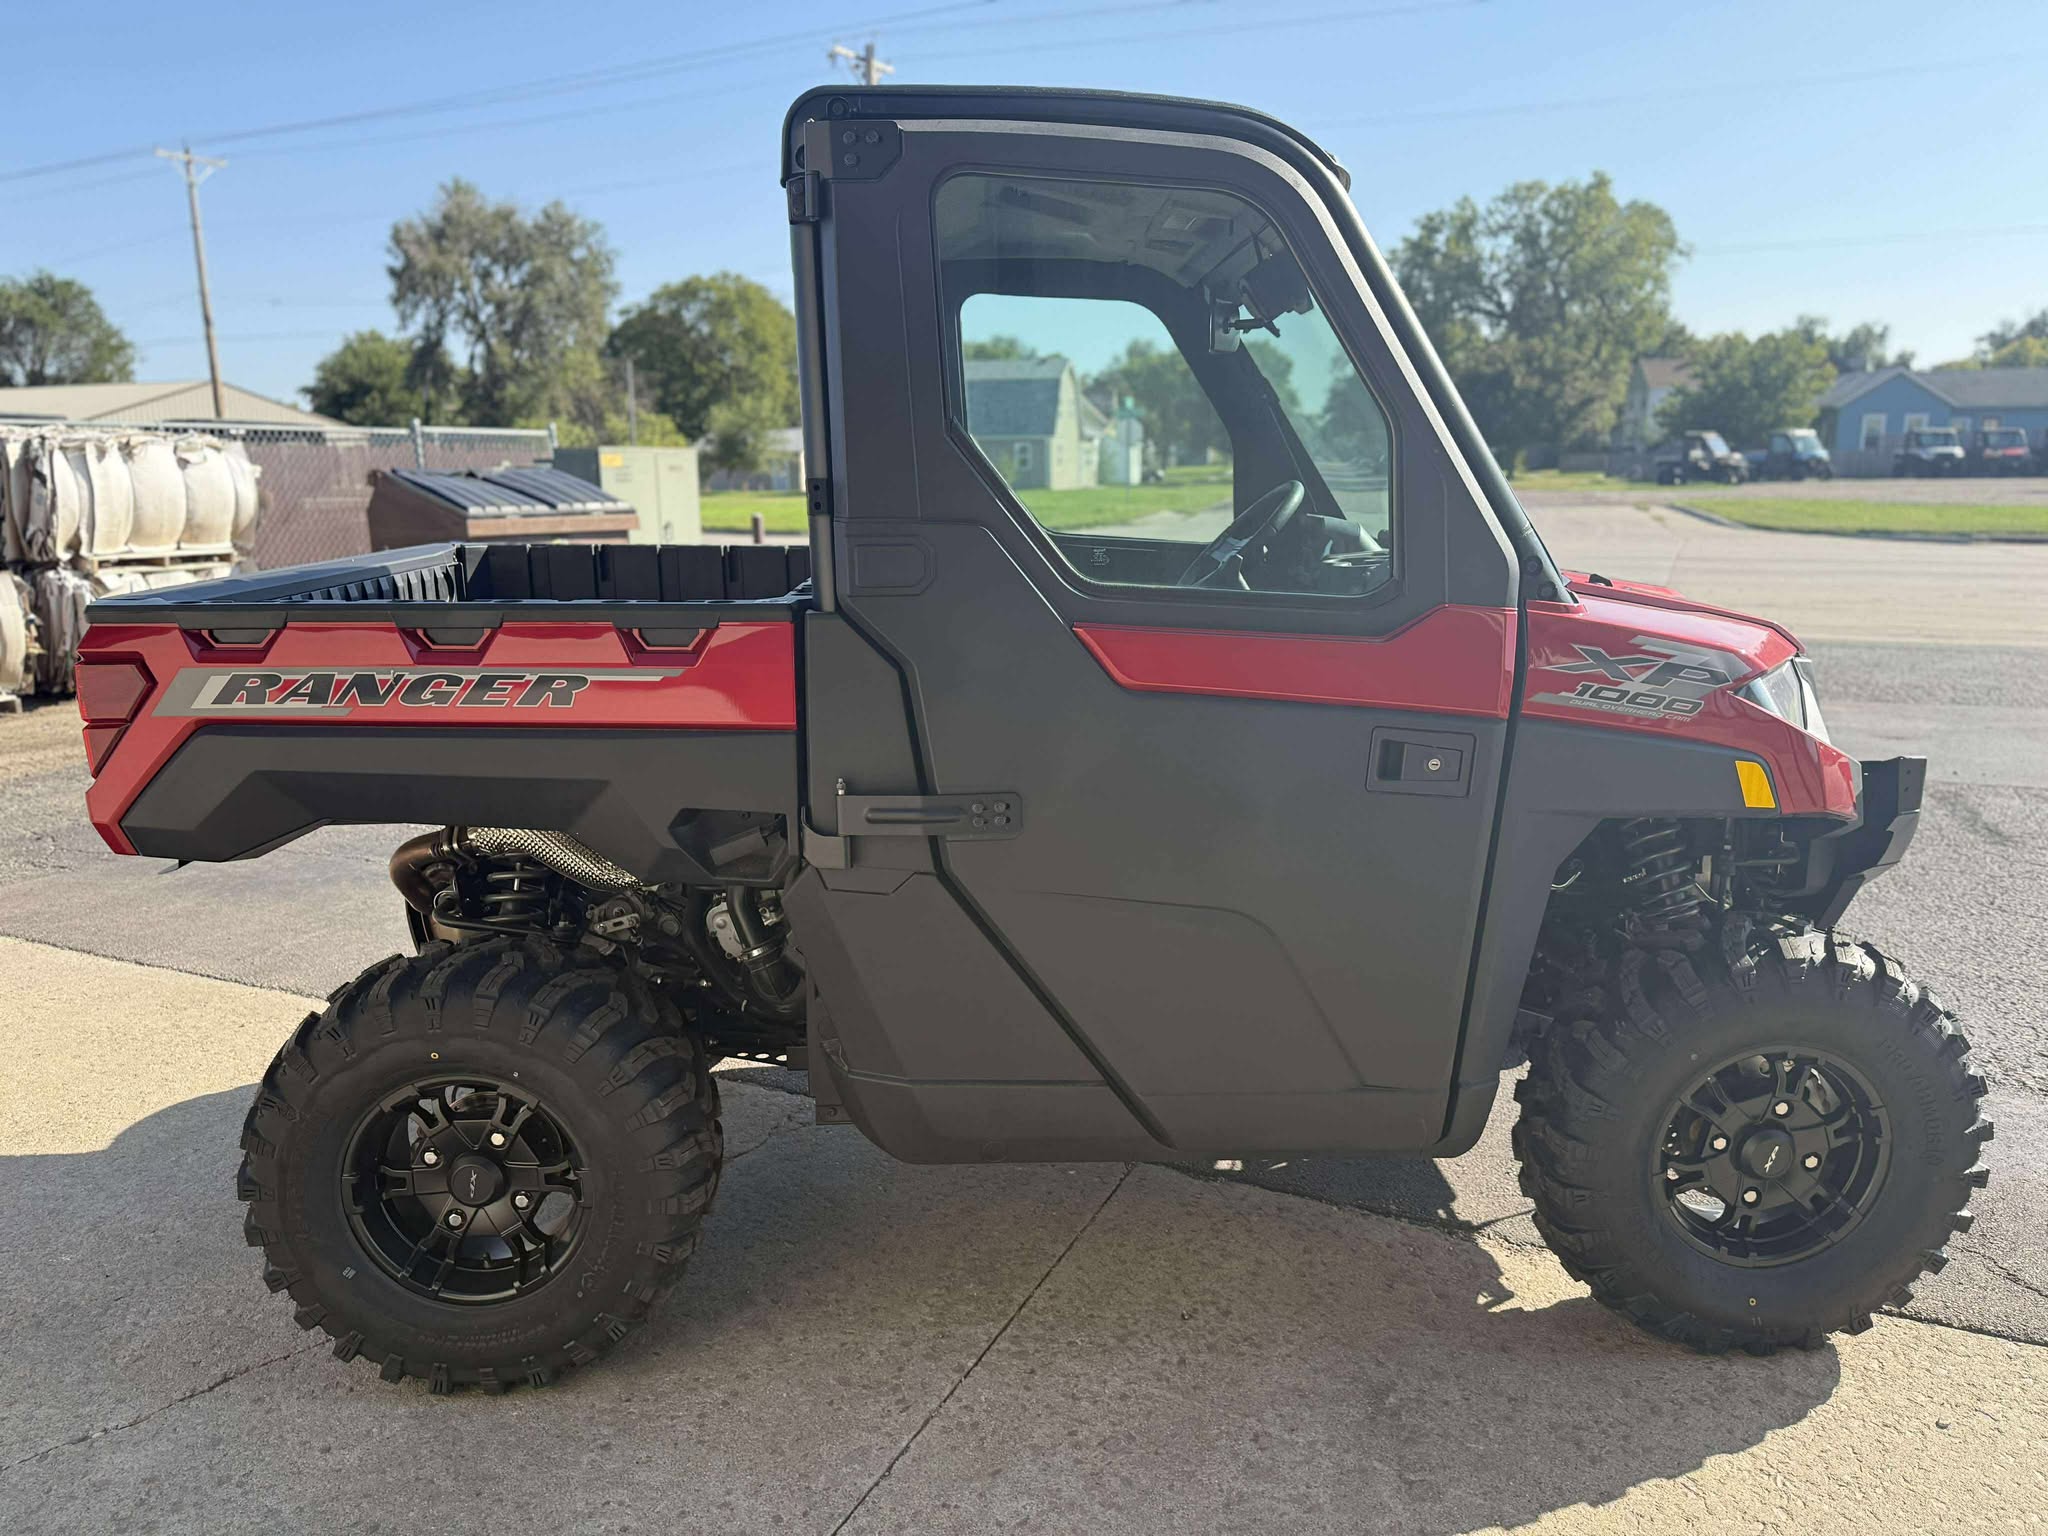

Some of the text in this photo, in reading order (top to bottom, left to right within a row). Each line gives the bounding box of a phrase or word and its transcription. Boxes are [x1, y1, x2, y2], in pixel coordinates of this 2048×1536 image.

[1537, 643, 1733, 688] XP
[209, 671, 590, 708] RANGER
[1573, 681, 1704, 717] 1000
[1569, 699, 1692, 722] DUAL OVERHEAD CAM
